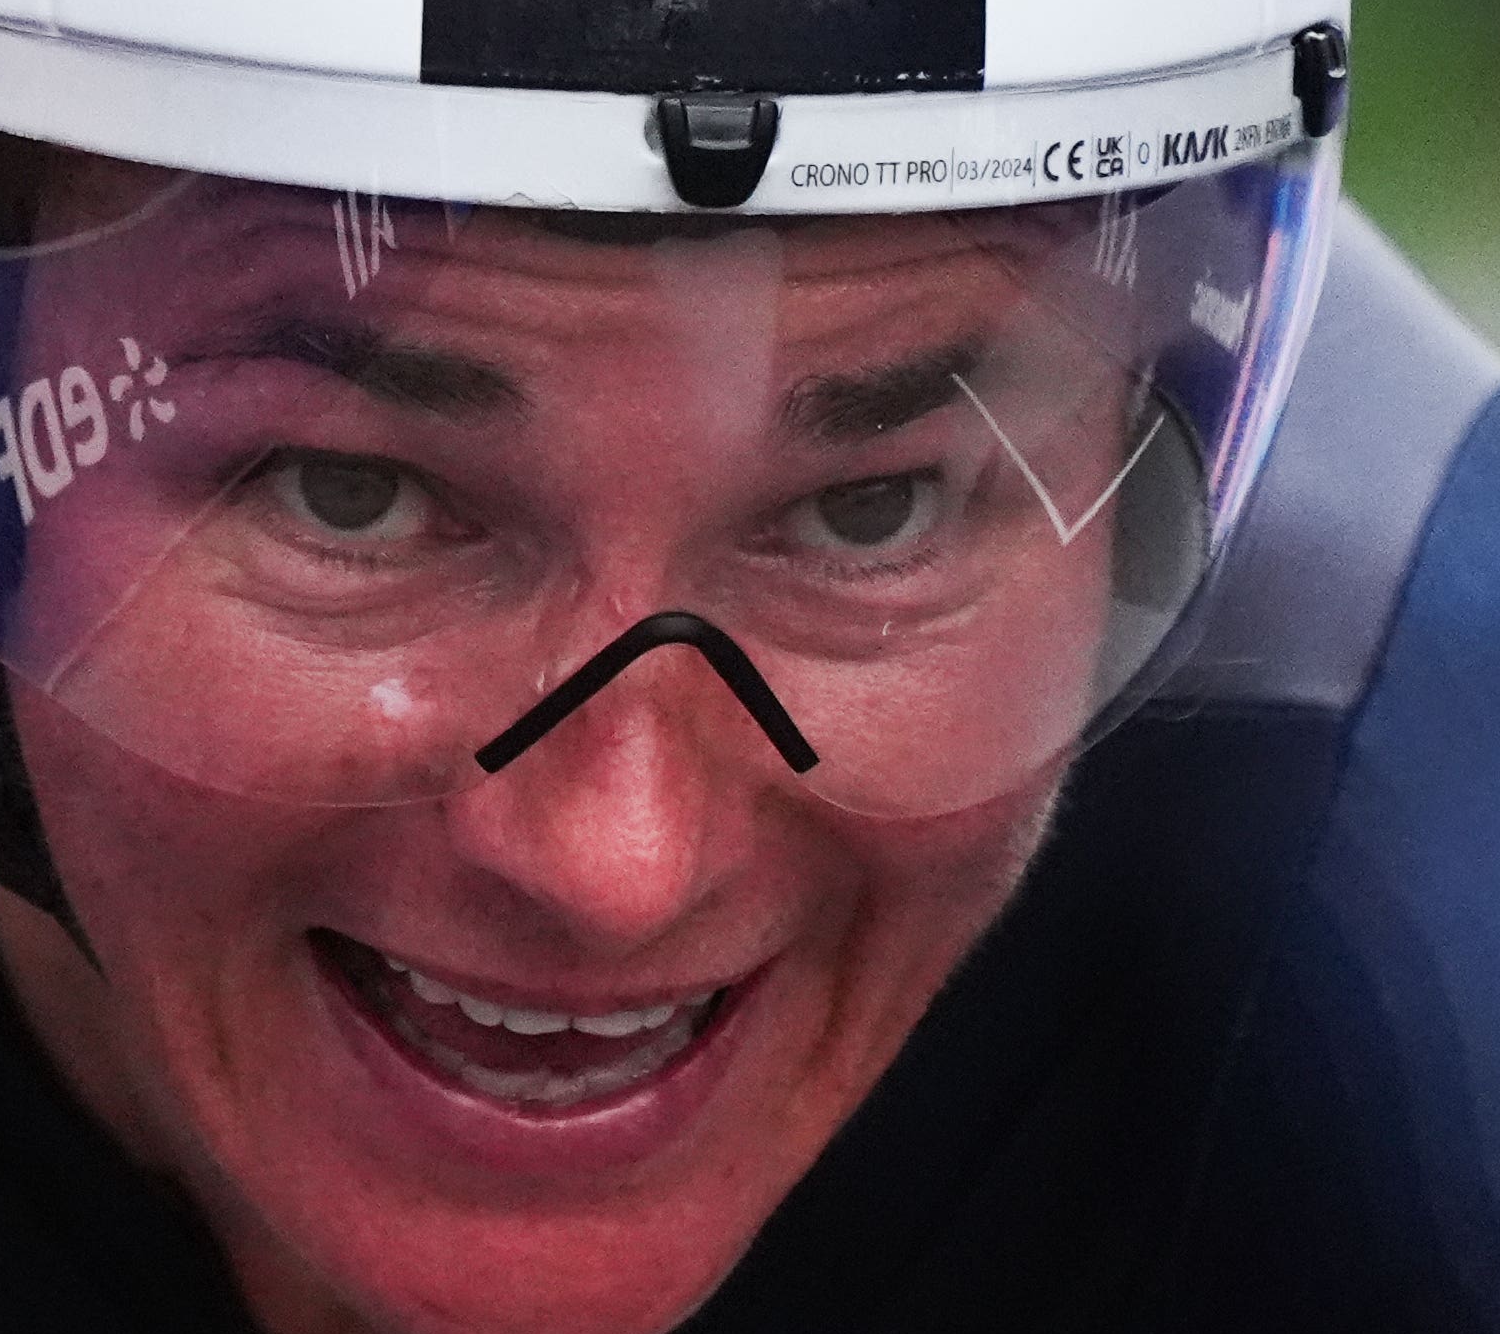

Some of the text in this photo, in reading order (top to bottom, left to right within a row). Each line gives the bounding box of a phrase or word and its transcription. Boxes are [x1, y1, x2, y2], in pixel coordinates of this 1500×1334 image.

[1096, 135, 1124, 157] UK
[791, 162, 870, 187] CRONO
[875, 161, 900, 186] TT
[906, 158, 949, 184] PRO
[956, 156, 1032, 181] 03/2024
[1043, 140, 1085, 182] CE
[1095, 157, 1124, 179] CA
